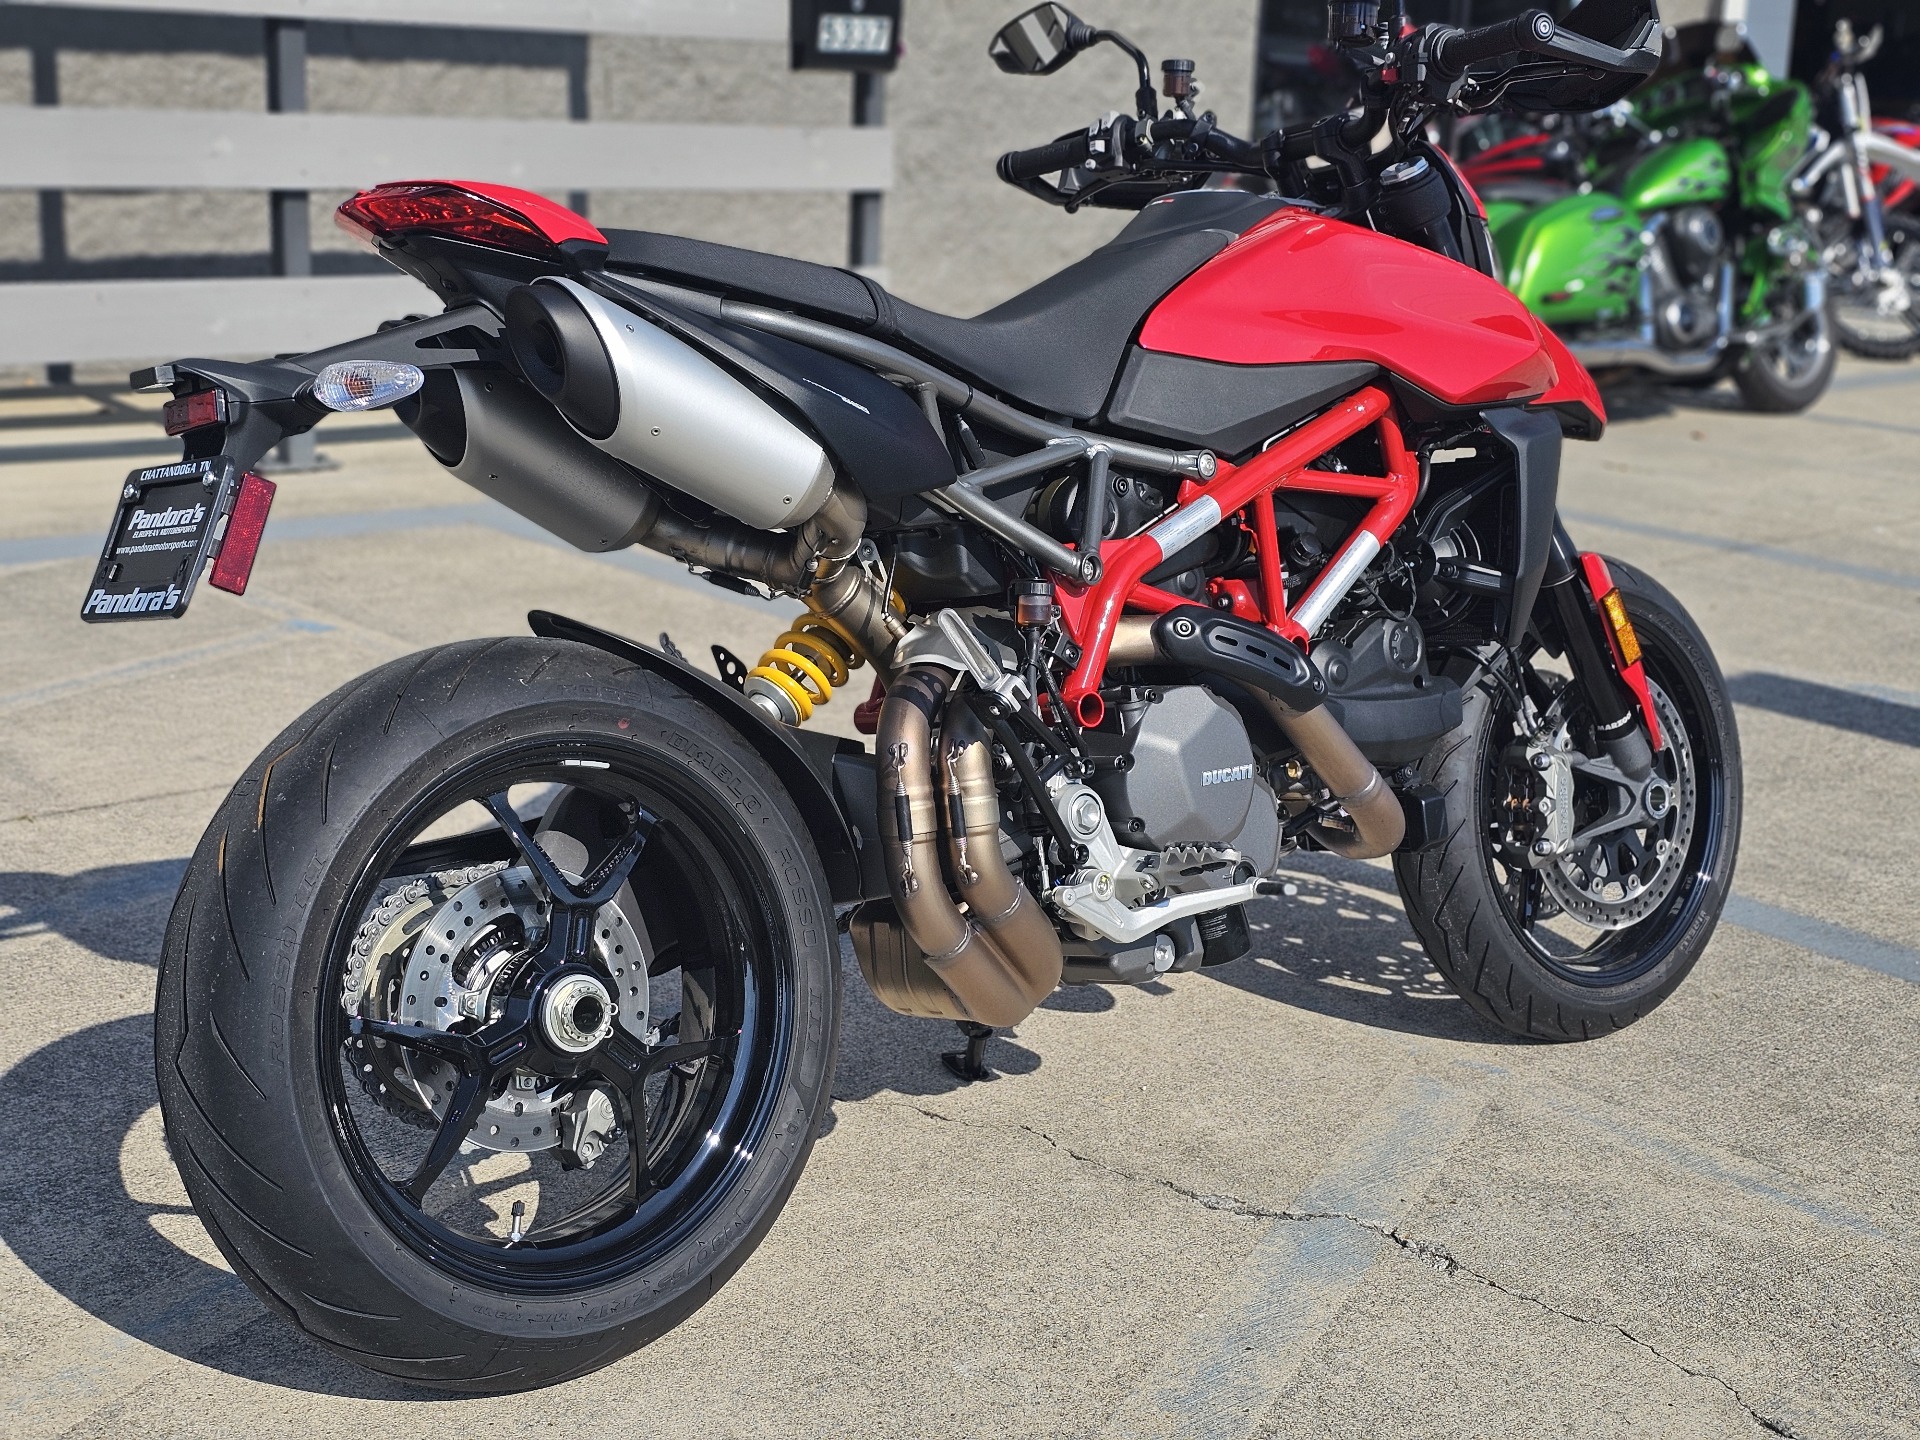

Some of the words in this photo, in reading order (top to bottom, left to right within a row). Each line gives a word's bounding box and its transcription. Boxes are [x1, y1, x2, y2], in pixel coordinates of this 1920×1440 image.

[141, 462, 196, 481] CHATTANOOGA
[200, 460, 212, 472] TN
[128, 503, 206, 530] Pandora's
[159, 525, 197, 535] MOTORSPORTS
[83, 584, 181, 614] Pandora's
[1201, 763, 1253, 787] DUCATI
[666, 729, 762, 815] DIABLO
[775, 848, 817, 948] ROSSO
